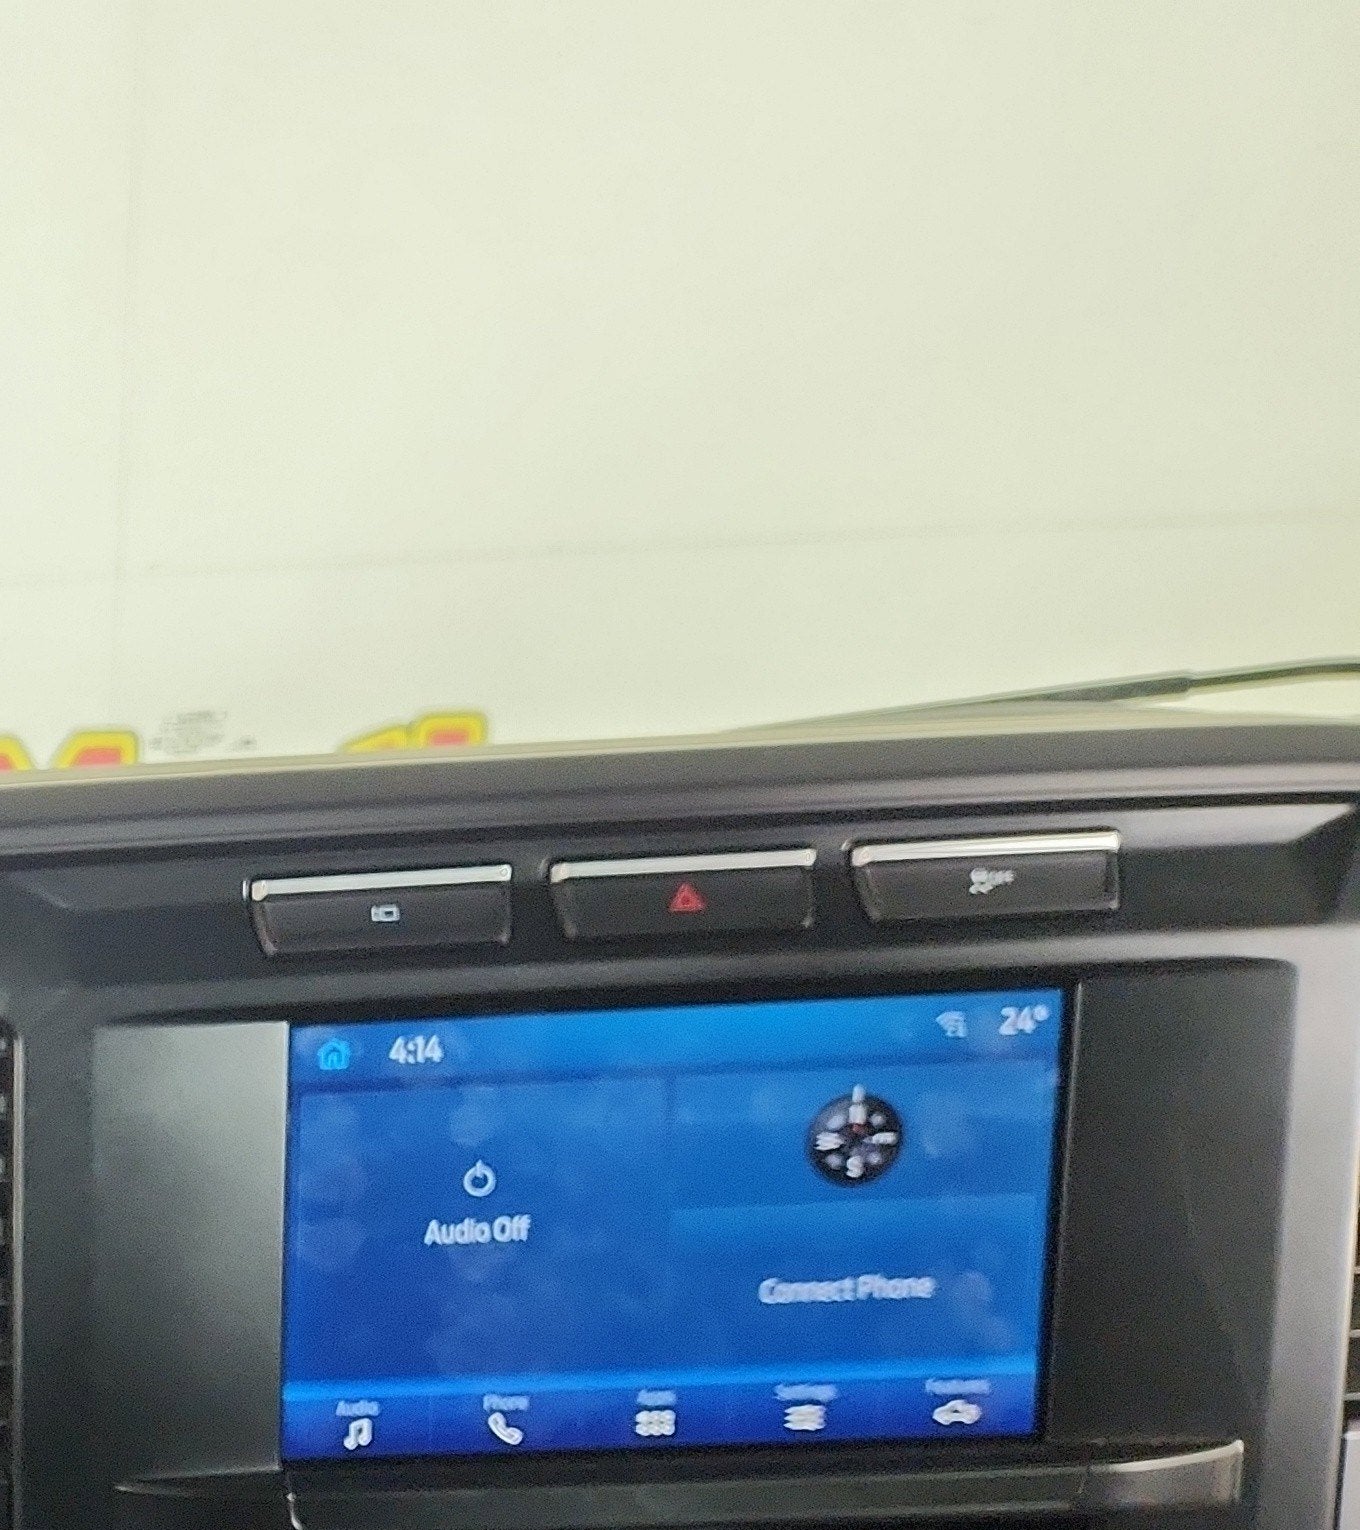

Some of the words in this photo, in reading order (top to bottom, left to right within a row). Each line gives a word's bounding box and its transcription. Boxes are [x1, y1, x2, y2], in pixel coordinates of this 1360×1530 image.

[388, 1035, 444, 1064] 4:14
[424, 1217, 491, 1245] Audio
[493, 1213, 531, 1242] Off
[759, 1277, 856, 1304] Connect
[857, 1274, 936, 1299] Phone
